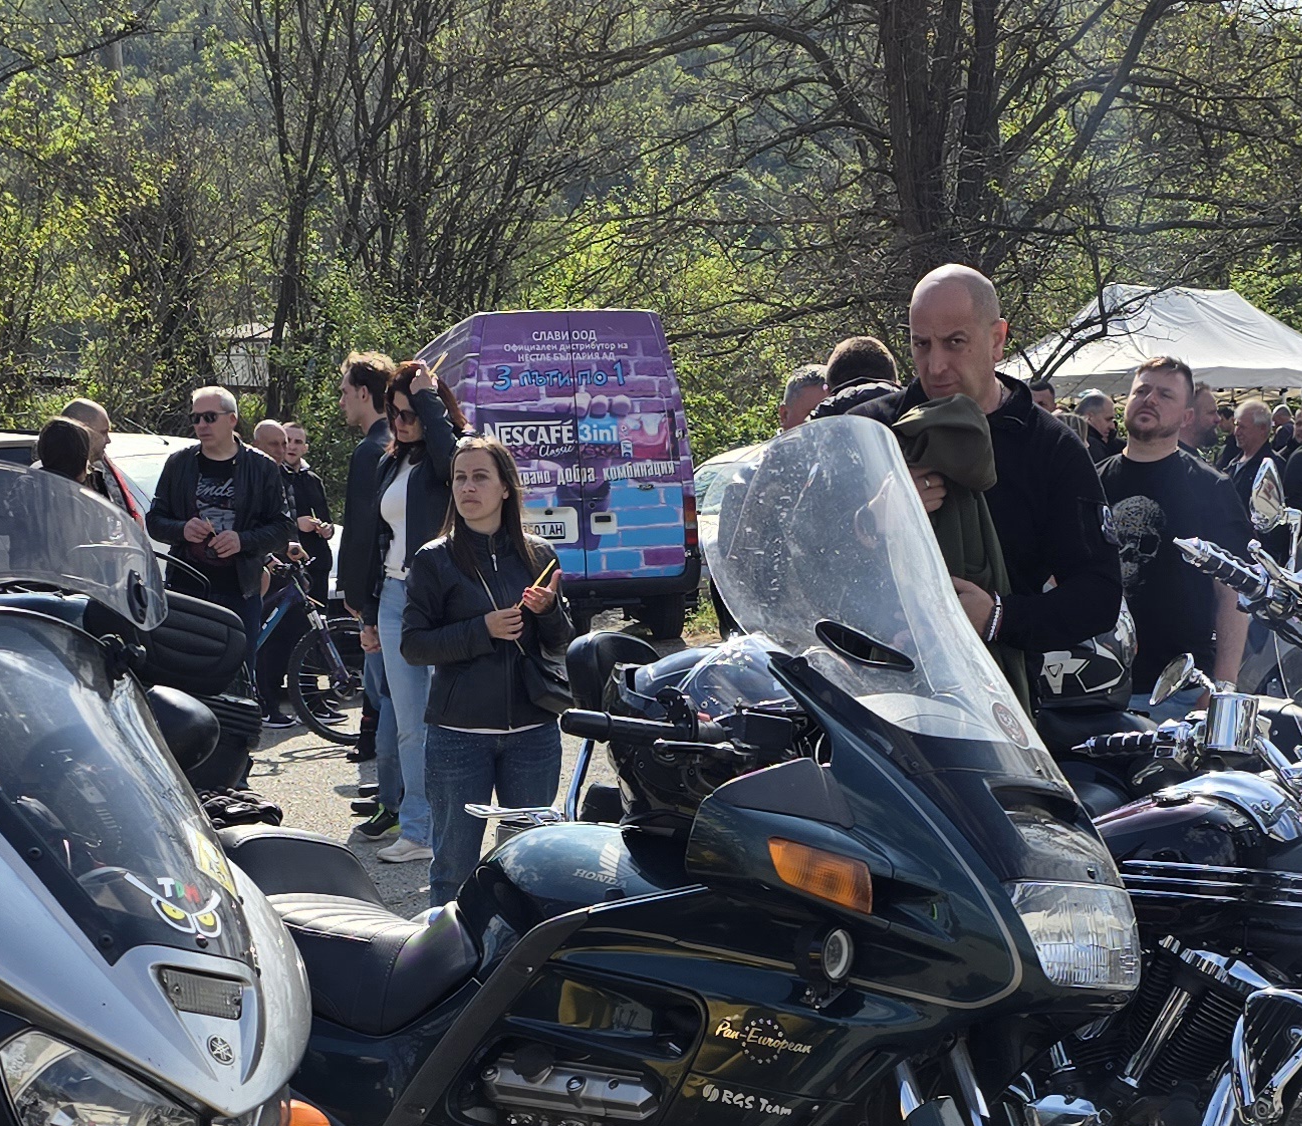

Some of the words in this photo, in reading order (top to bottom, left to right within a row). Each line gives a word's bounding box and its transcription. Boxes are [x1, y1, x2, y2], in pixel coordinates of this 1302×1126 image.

[532, 330, 570, 341] СЛАВИ
[572, 330, 597, 342] ООД
[492, 365, 512, 391] 3
[518, 369, 571, 389] пъти
[577, 368, 609, 386] по
[613, 359, 626, 386] 1
[484, 420, 575, 446] NESCAFÉ
[579, 424, 618, 442] 3in1
[539, 444, 574, 458] Classic
[195, 473, 235, 497] ende
[518, 470, 551, 486] квано
[557, 464, 595, 486] добра
[603, 461, 675, 482] комбинация
[156, 877, 201, 903] TDM
[572, 868, 628, 888] HONDA
[715, 1020, 812, 1054] Pan-European
[721, 1090, 755, 1109] RGS
